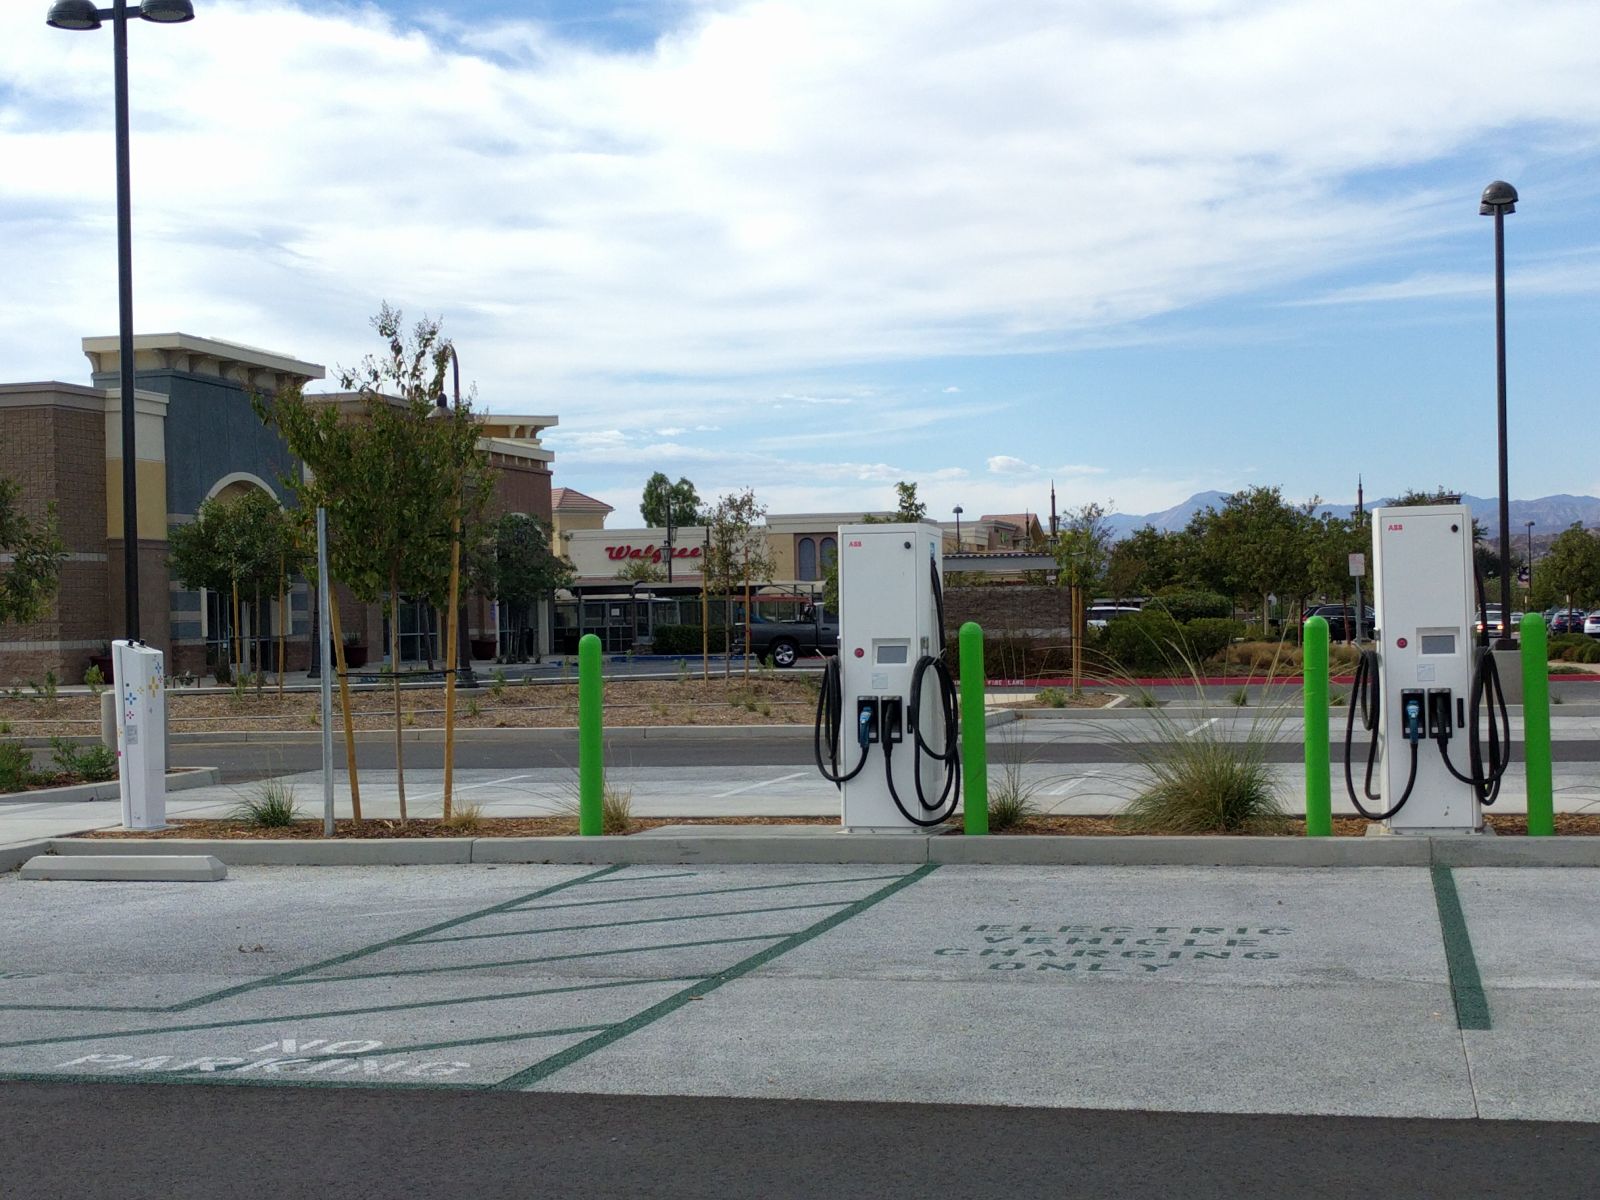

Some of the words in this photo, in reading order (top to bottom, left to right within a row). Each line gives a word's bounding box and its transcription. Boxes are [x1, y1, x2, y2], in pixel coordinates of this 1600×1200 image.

[975, 925, 1294, 935] ELECTRIC
[984, 936, 1261, 947] VEHICLE
[933, 948, 1280, 960] CHARGING
[988, 962, 1174, 972] ONLY
[249, 1039, 383, 1053] NO
[55, 1054, 471, 1077] PARKING
